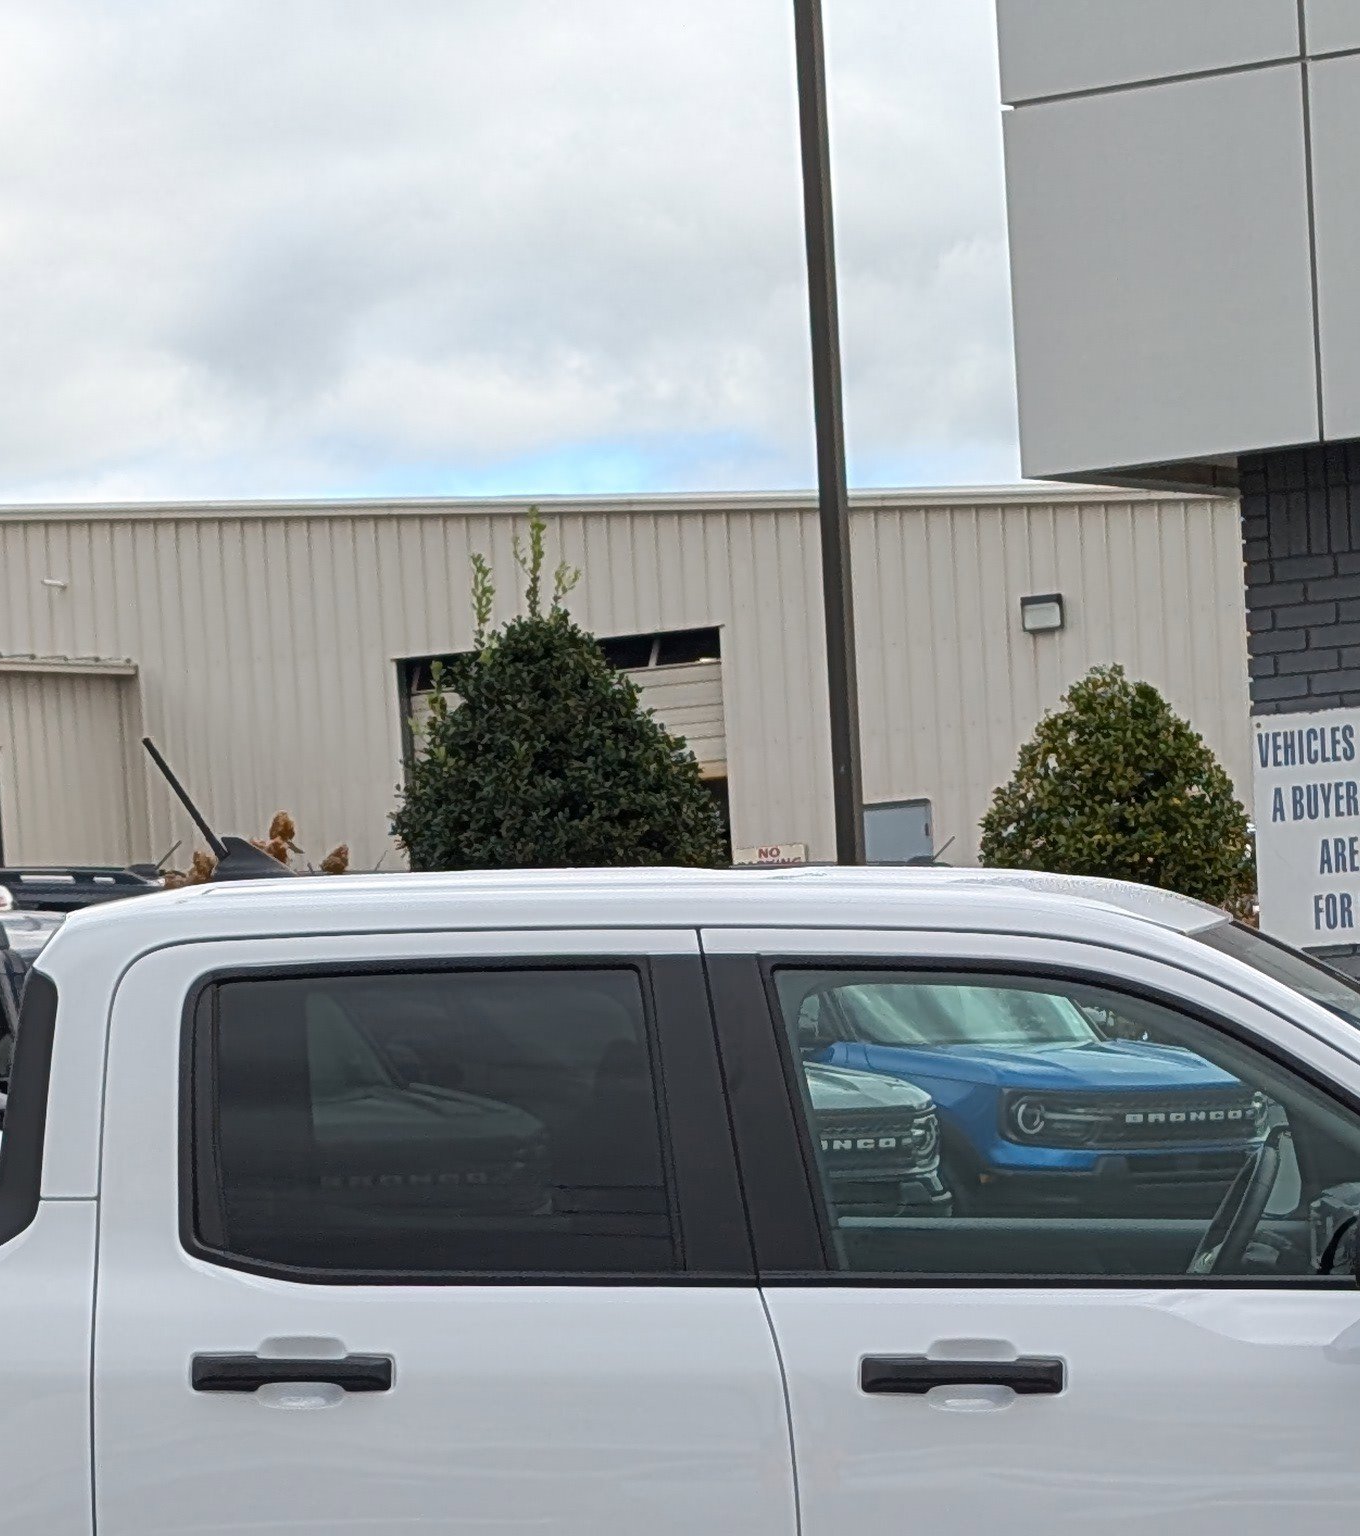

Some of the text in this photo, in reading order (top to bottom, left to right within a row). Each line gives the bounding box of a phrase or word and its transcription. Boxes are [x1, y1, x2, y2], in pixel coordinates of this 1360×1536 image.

[1257, 724, 1355, 768] VEHICLES
[1272, 787, 1286, 822] A
[758, 847, 781, 858] NO
[1319, 836, 1360, 874] ARE
[1314, 892, 1354, 930] FOR
[1125, 1109, 1242, 1123] BRONCO
